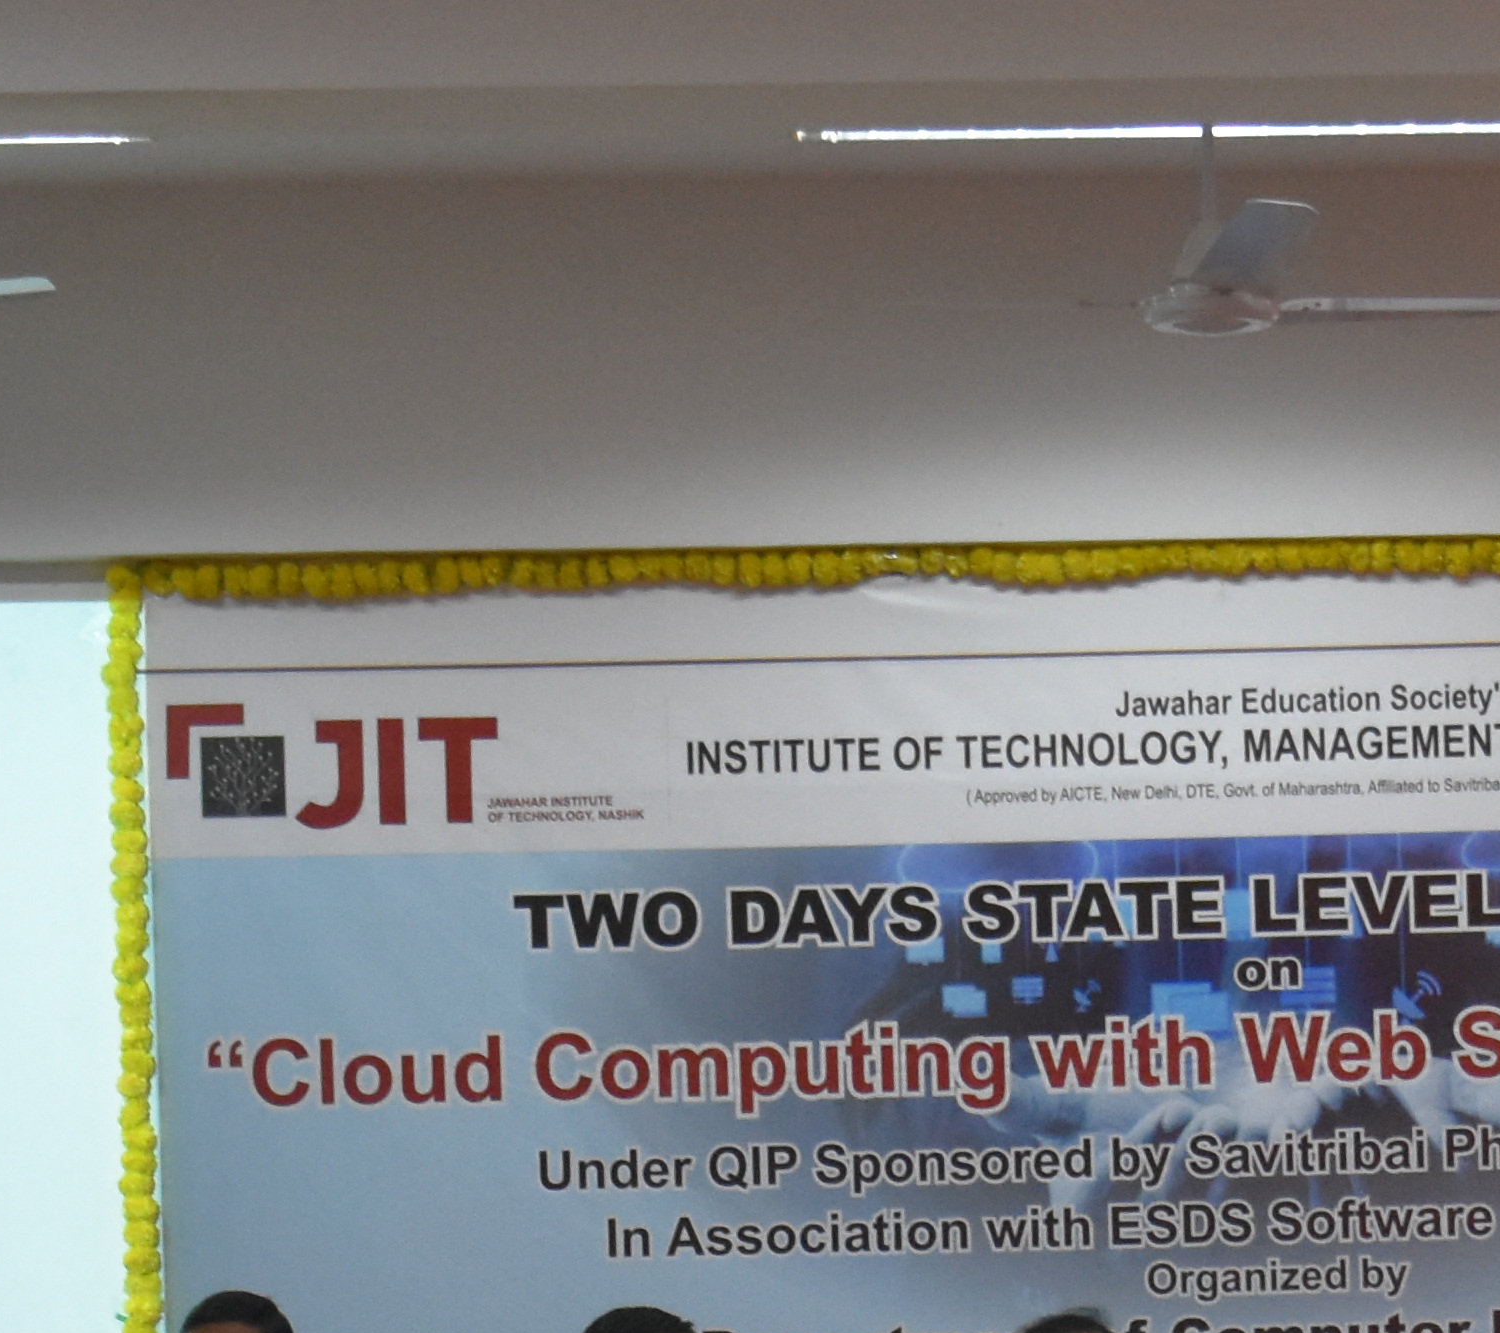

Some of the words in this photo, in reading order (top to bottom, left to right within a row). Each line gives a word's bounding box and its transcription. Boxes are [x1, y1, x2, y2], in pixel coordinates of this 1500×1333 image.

[1115, 687, 1232, 719] Jawahar
[1241, 683, 1381, 715] Education
[295, 716, 498, 830] JIT
[685, 737, 882, 777] INSTITUTE
[893, 737, 949, 773] OF
[955, 729, 1234, 773] TECHNOLOGY,
[487, 796, 548, 809] JAWAHAR
[550, 795, 614, 807] INSTITUTE
[1041, 787, 1058, 804] by
[1111, 785, 1141, 801] New
[1261, 782, 1275, 798] of
[1367, 779, 1423, 795] Affiliated
[1427, 779, 1440, 794] to
[487, 811, 504, 823] OF
[598, 809, 644, 821] NASHIK
[513, 887, 700, 952] TWO
[729, 883, 940, 948] DAYS
[963, 874, 1226, 943] STATE
[1235, 952, 1303, 992] on
[534, 1021, 1008, 1116] Computing
[1029, 1016, 1213, 1092] with
[1237, 1006, 1428, 1084] Web
[537, 1147, 691, 1193] Under
[708, 1144, 797, 1192] QIP
[815, 1135, 1093, 1194] Sponsored
[1110, 1134, 1168, 1186] by
[1185, 1126, 1429, 1180] Savitribai
[607, 1217, 652, 1259] In
[667, 1210, 970, 1258] Association
[987, 1207, 1092, 1250] with
[1109, 1203, 1254, 1249] ESDS
[1270, 1195, 1493, 1245] Software
[1146, 1257, 1349, 1299] Organized
[1360, 1256, 1408, 1298] by
